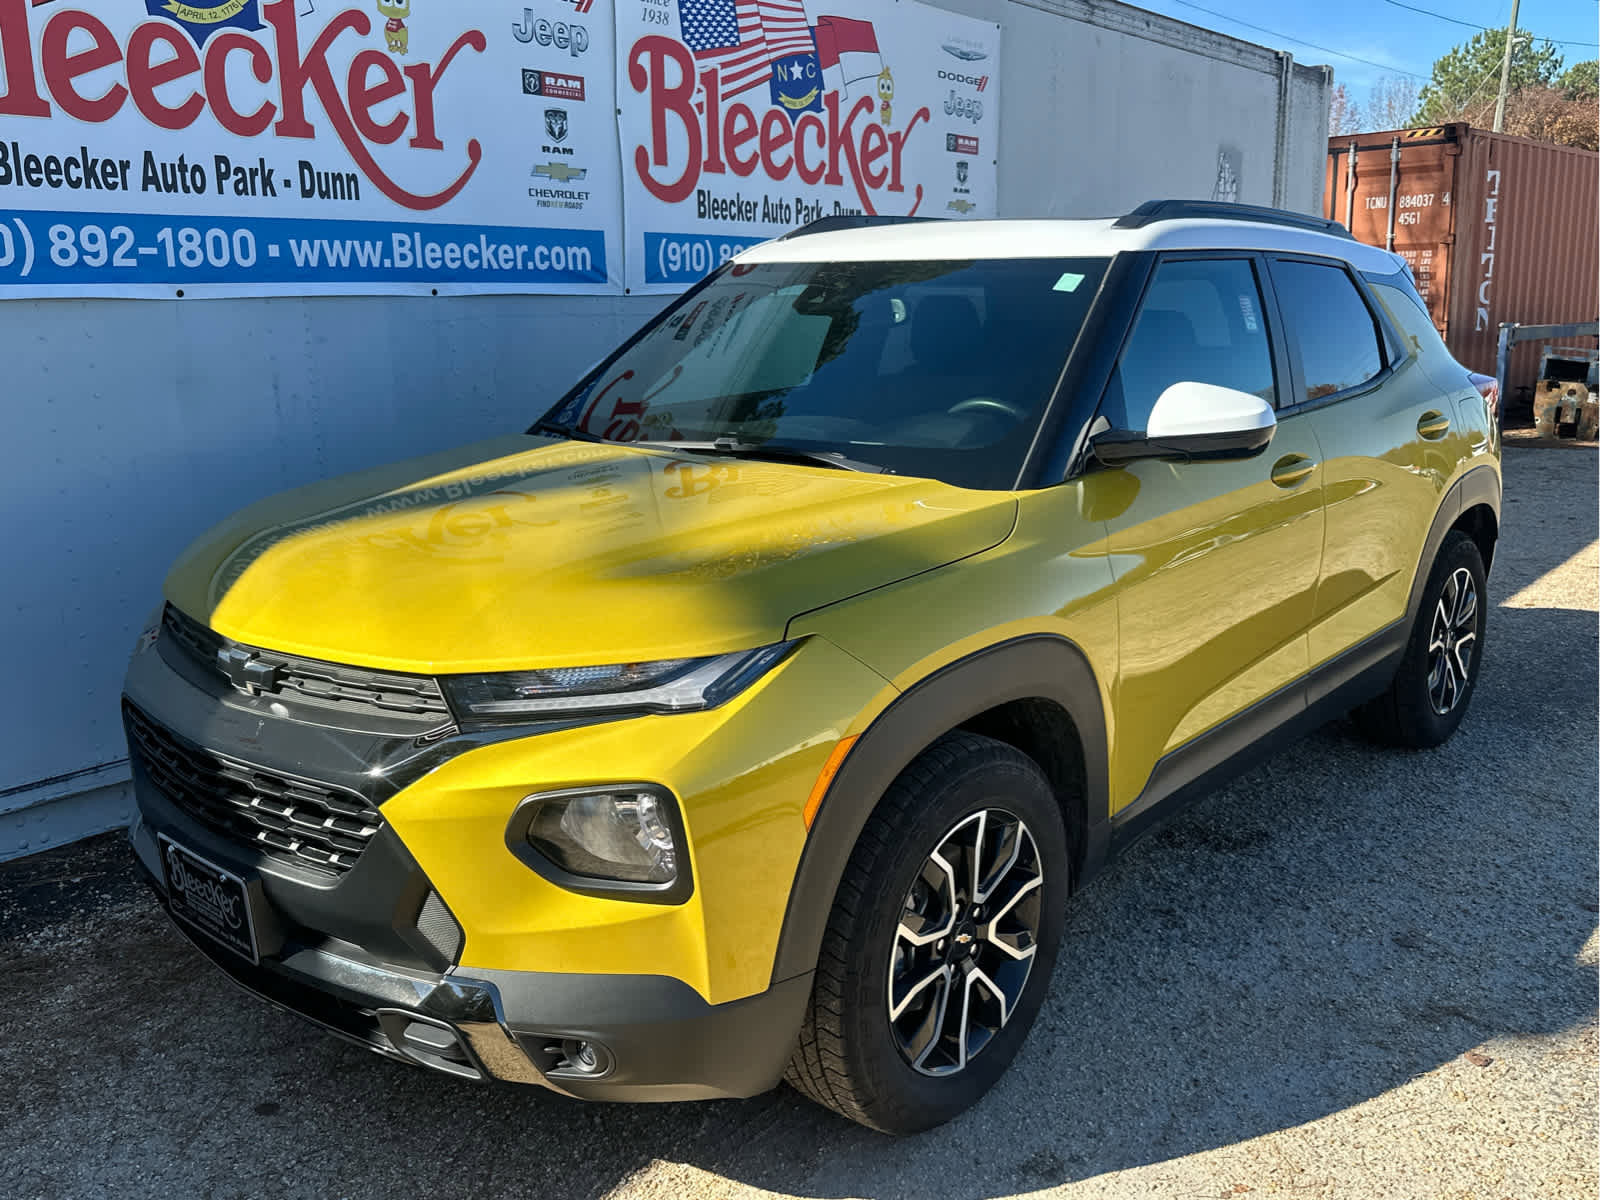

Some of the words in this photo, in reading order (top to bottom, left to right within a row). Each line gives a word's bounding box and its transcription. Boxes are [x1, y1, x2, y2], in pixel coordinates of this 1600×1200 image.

[180, 8, 207, 21] APRIL
[221, 2, 239, 16] 1776
[642, 7, 670, 26] 1938
[512, 7, 589, 57] Jeep
[545, 76, 581, 89] RAM
[777, 63, 789, 82] N
[938, 70, 982, 87] DODGE
[0, 0, 487, 211] leecker
[943, 89, 984, 125] Jeep
[628, 35, 930, 217] Bleecker
[541, 145, 574, 156] RAM
[0, 141, 131, 191] Bleecker
[141, 150, 207, 195] Auto
[214, 154, 278, 198] Park
[298, 159, 360, 201] Dunn
[528, 187, 591, 201] CHEVROLET
[697, 189, 758, 222] Bleecker
[762, 194, 792, 225] Auto
[795, 197, 823, 225] Park
[1365, 197, 1387, 209] TCNU
[1399, 193, 1435, 209] 884037
[1442, 192, 1450, 206] 4
[48, 223, 257, 268] 892-1800
[288, 231, 592, 272] www.Bleecker.com
[658, 238, 714, 279] (910)
